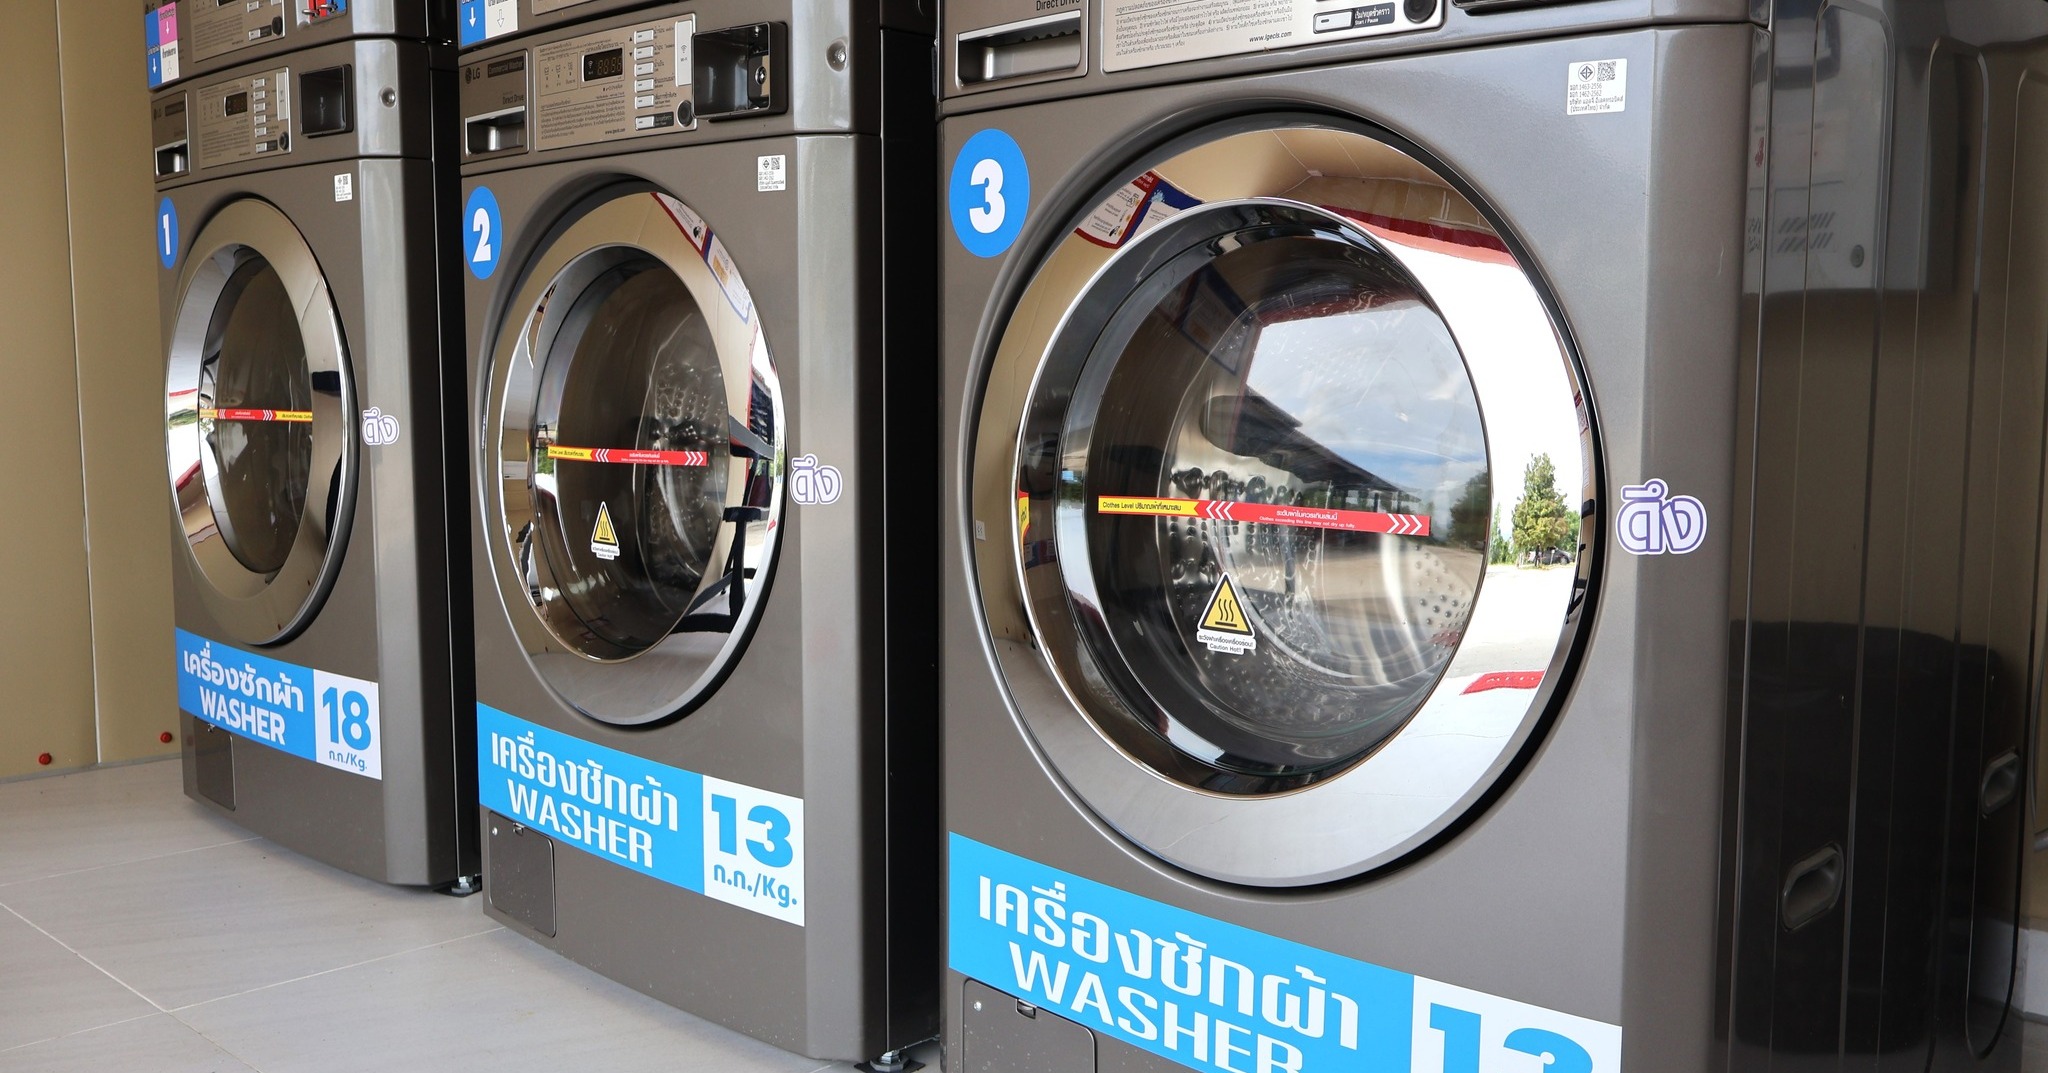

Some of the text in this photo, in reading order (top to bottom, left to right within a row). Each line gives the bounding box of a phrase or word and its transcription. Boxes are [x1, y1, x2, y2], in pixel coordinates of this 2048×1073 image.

[1037, 0, 1058, 10] Direct
[472, 68, 480, 80] LG
[968, 158, 1006, 234] 3
[162, 213, 170, 256] 1
[472, 207, 492, 263] 2
[184, 641, 304, 713] เครื่องซักผ้า
[1210, 643, 1228, 651] Caution
[200, 685, 285, 745] WASHER
[322, 686, 371, 750] 18
[491, 731, 678, 832] เครื่องซักผ้า
[507, 778, 653, 869] WASHER
[711, 793, 793, 868] 13
[979, 875, 1359, 1051] เครื่องซักผ้า
[1008, 941, 1303, 1073] WASHER
